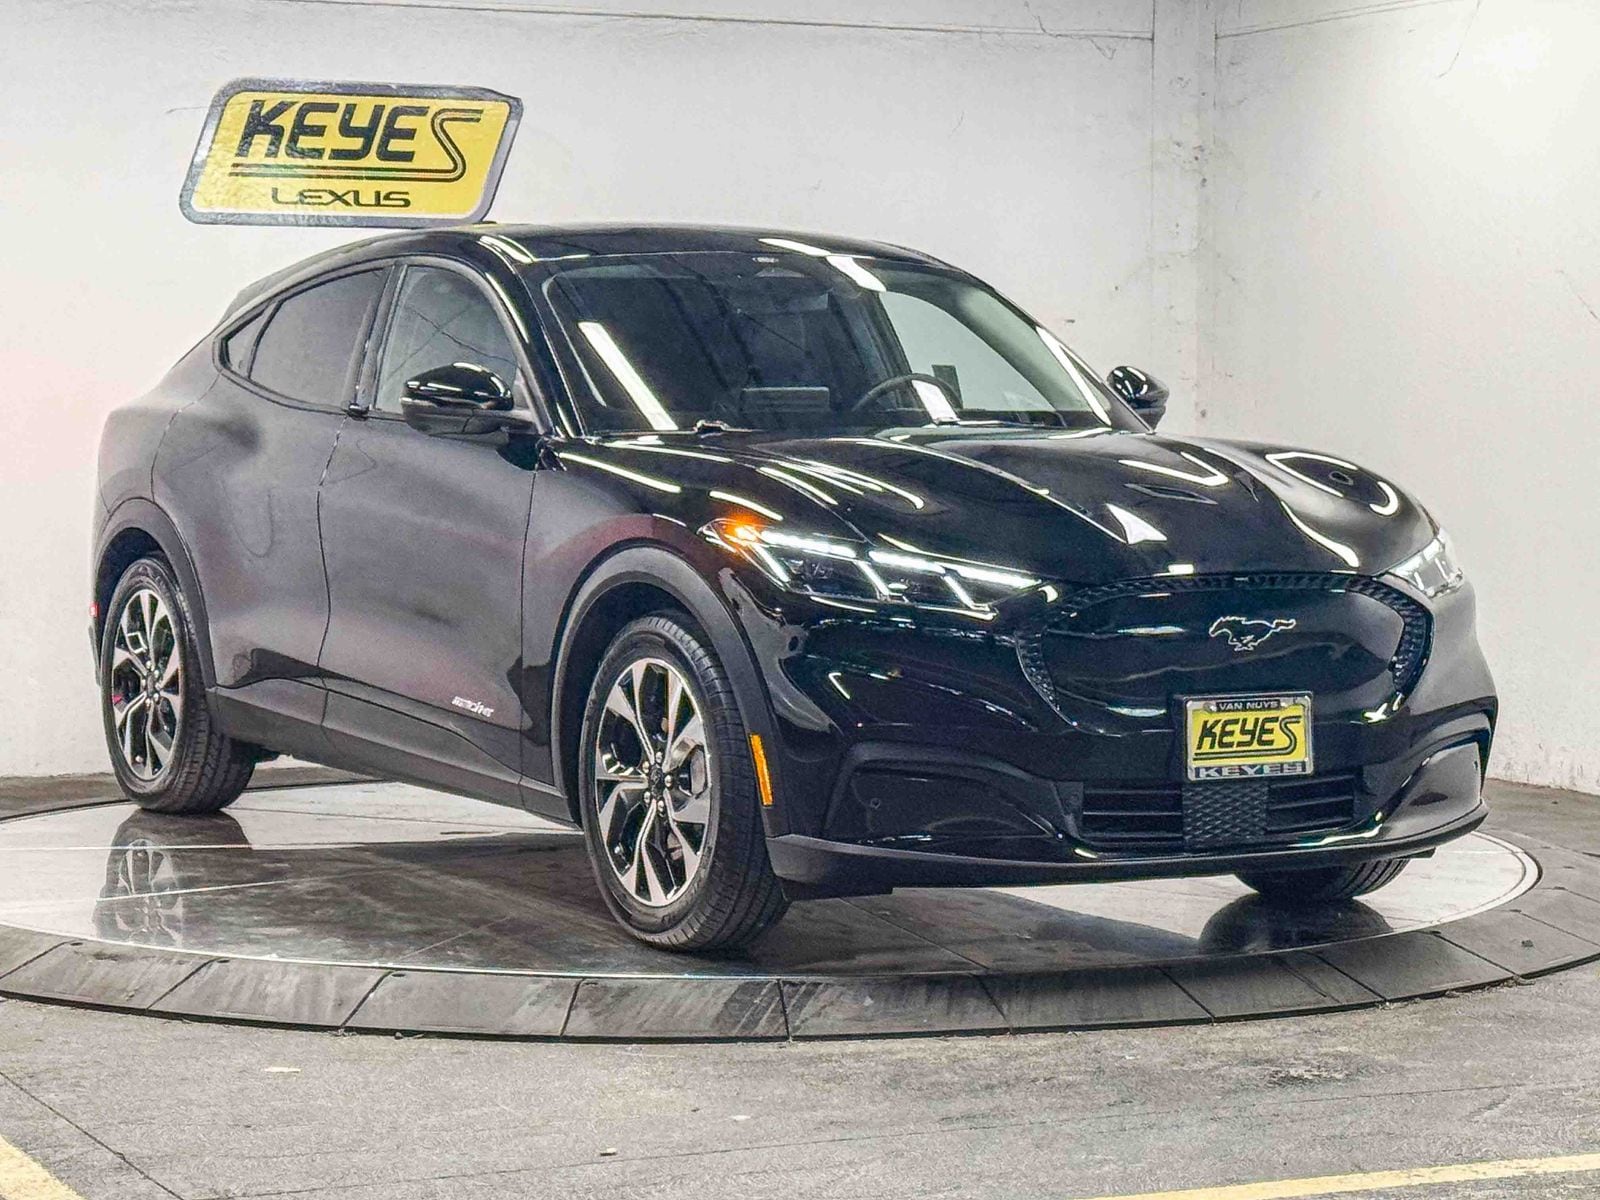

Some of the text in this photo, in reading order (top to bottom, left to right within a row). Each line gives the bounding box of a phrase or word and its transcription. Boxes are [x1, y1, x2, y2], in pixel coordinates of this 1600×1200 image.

[229, 99, 484, 182] KEYES
[271, 187, 411, 208] LEXUS
[1218, 700, 1280, 711] VAN NUYS
[1193, 715, 1303, 761] KEYES
